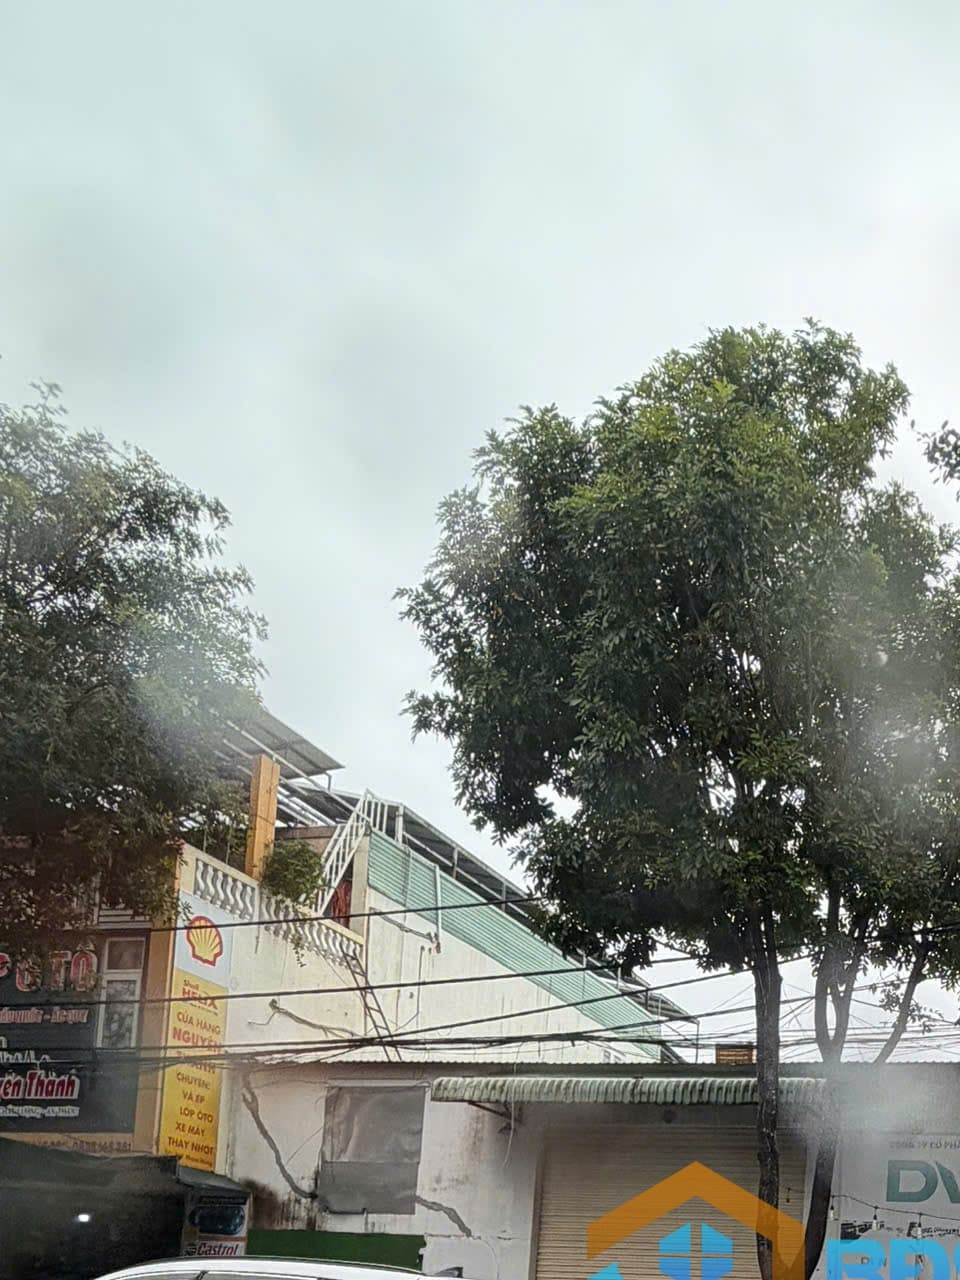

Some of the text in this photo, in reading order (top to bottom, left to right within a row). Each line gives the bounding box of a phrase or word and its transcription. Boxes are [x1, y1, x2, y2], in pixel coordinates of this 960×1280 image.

[175, 1121, 186, 1133] XE
[167, 1136, 190, 1151] THAY
[197, 1243, 239, 1256] Castrol
